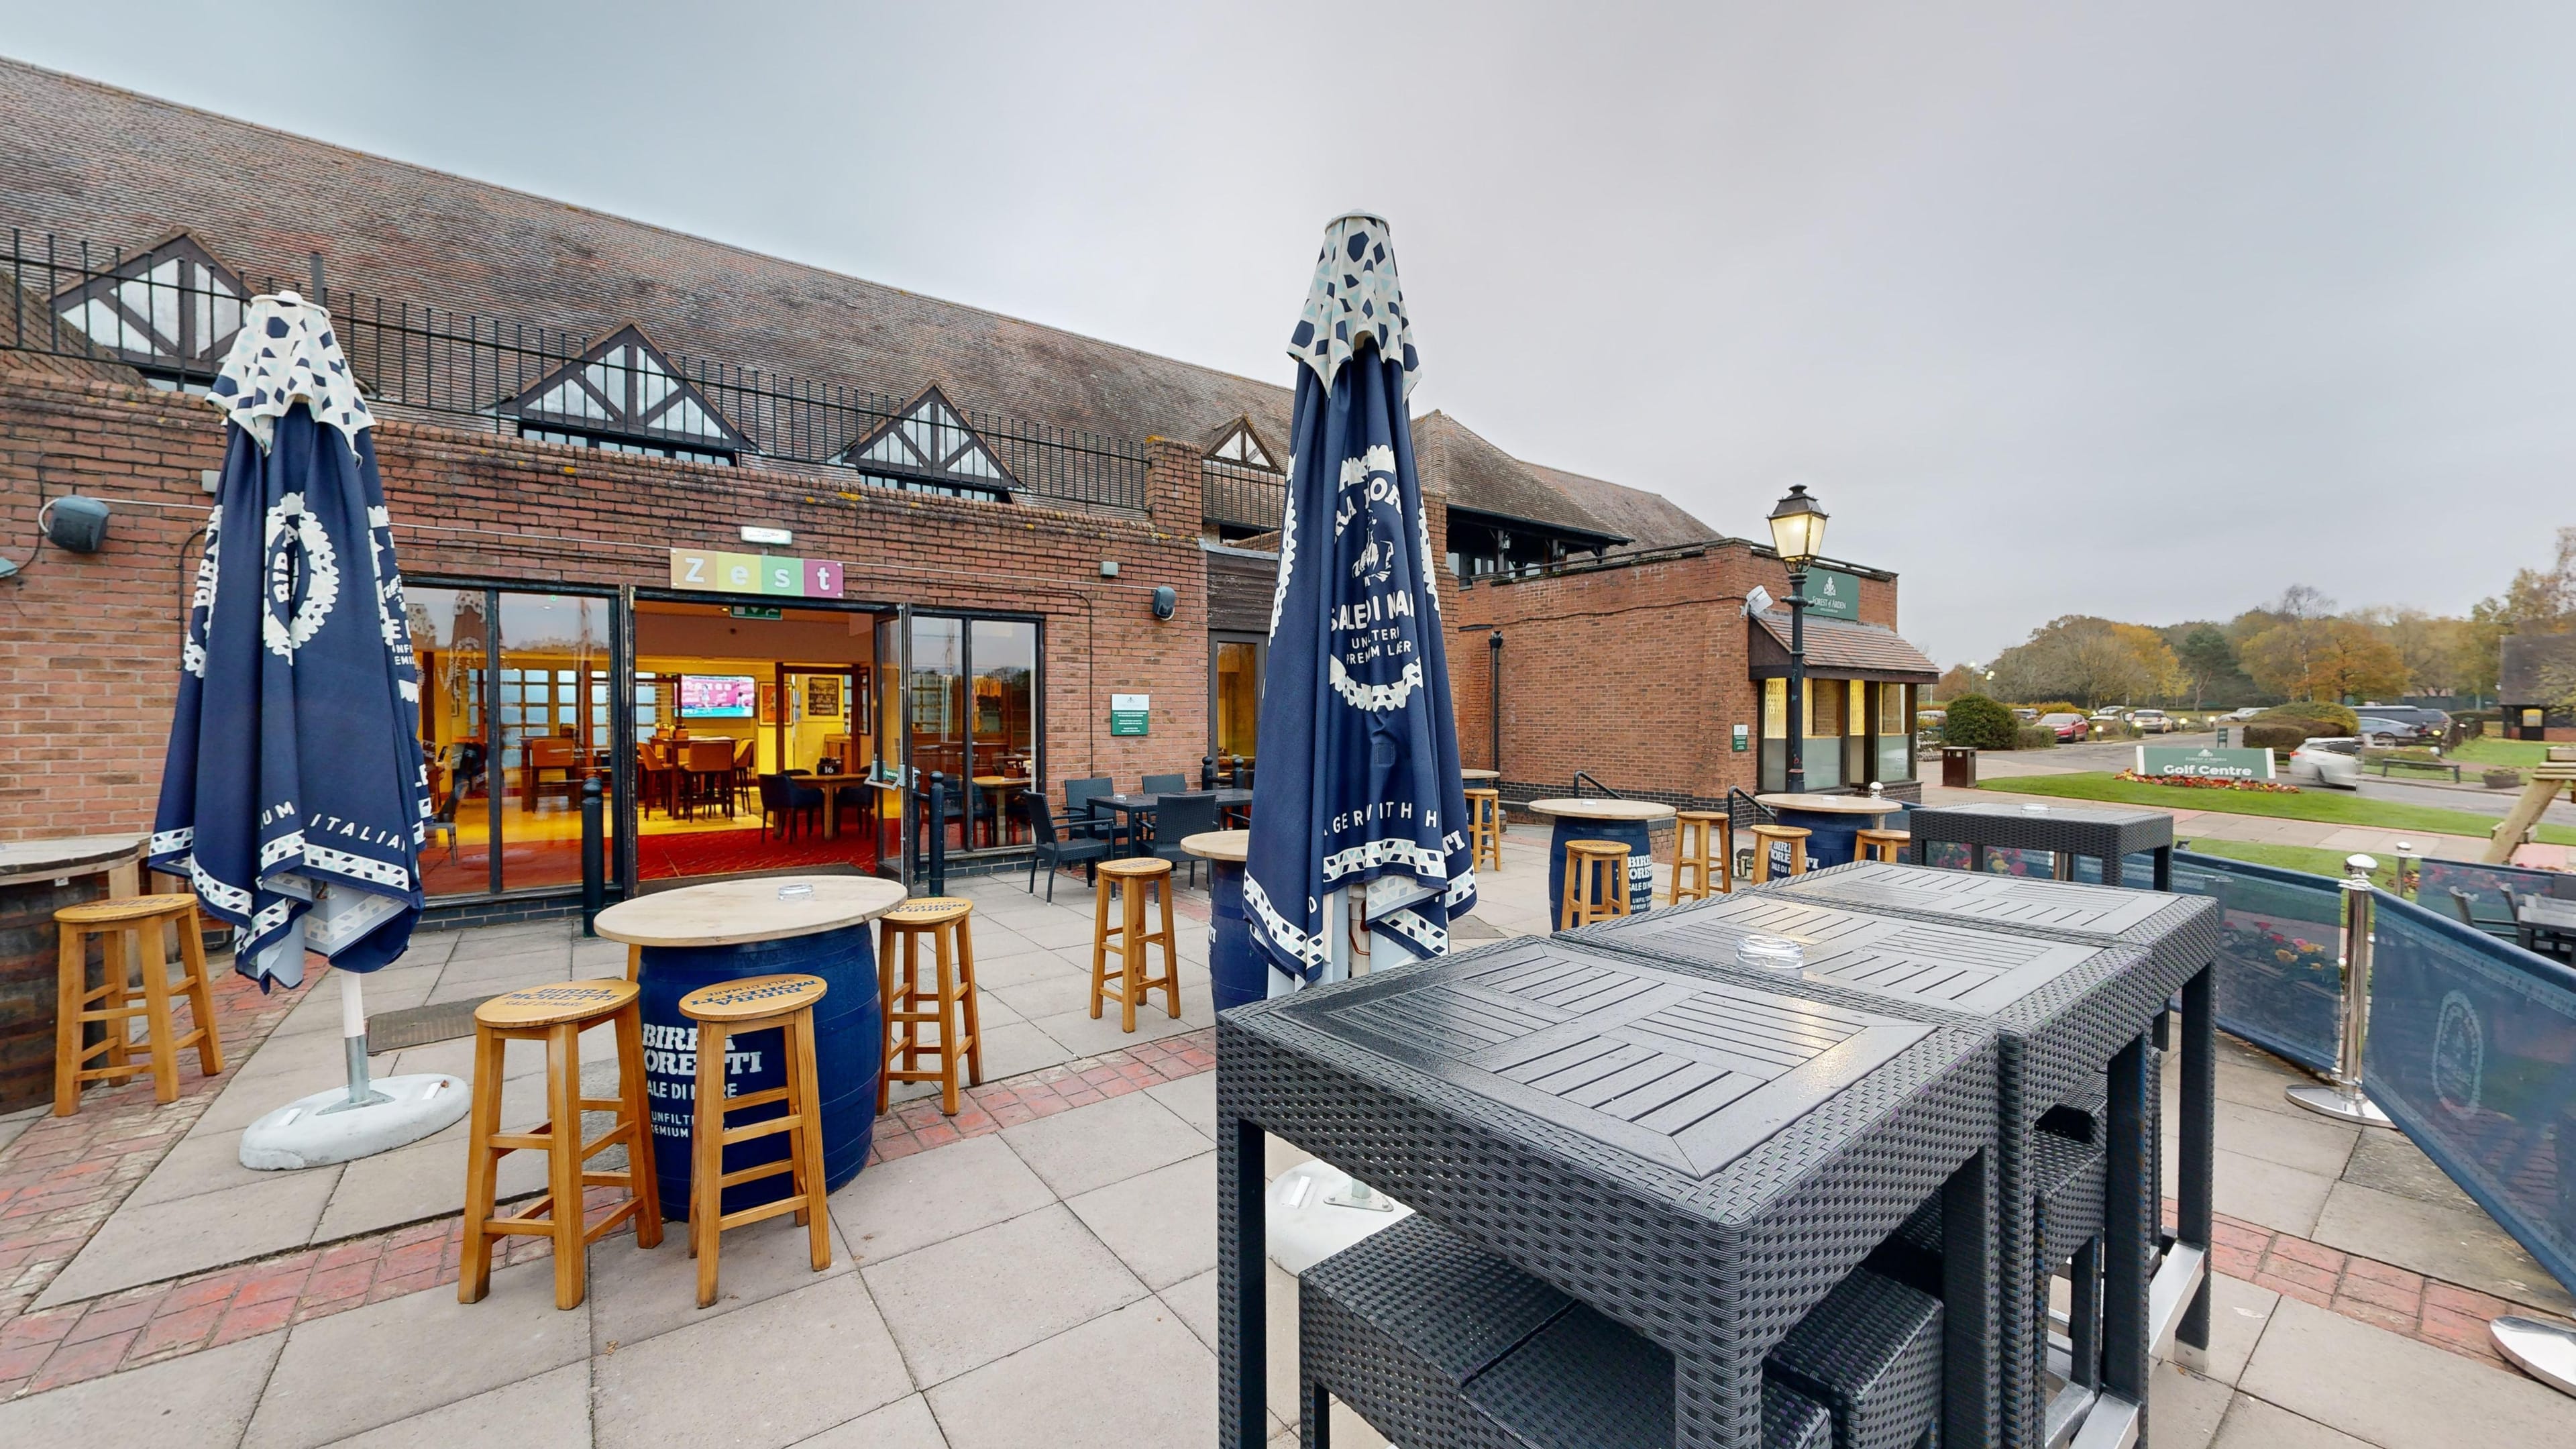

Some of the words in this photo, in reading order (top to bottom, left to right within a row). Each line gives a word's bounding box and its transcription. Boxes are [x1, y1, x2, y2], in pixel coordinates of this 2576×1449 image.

[684, 557, 830, 591] Zest
[2163, 764, 2196, 775] Golf
[2198, 765, 2253, 776] Centre
